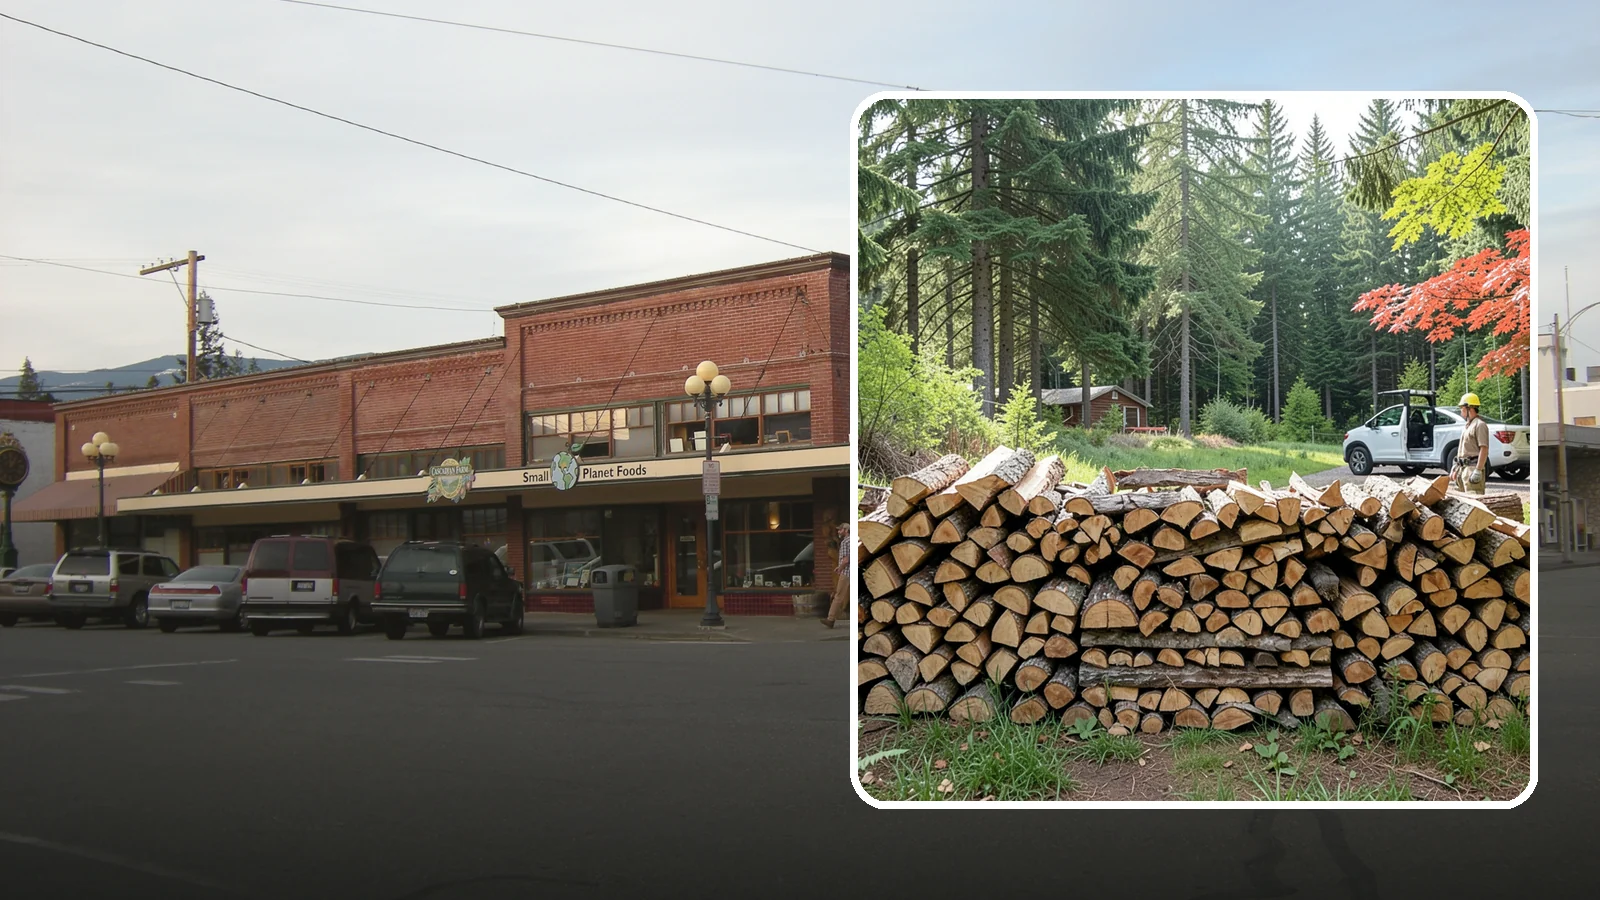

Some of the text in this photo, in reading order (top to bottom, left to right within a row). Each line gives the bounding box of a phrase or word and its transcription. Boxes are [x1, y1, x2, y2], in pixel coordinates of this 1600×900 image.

[523, 464, 647, 482] Small Planet Foods
